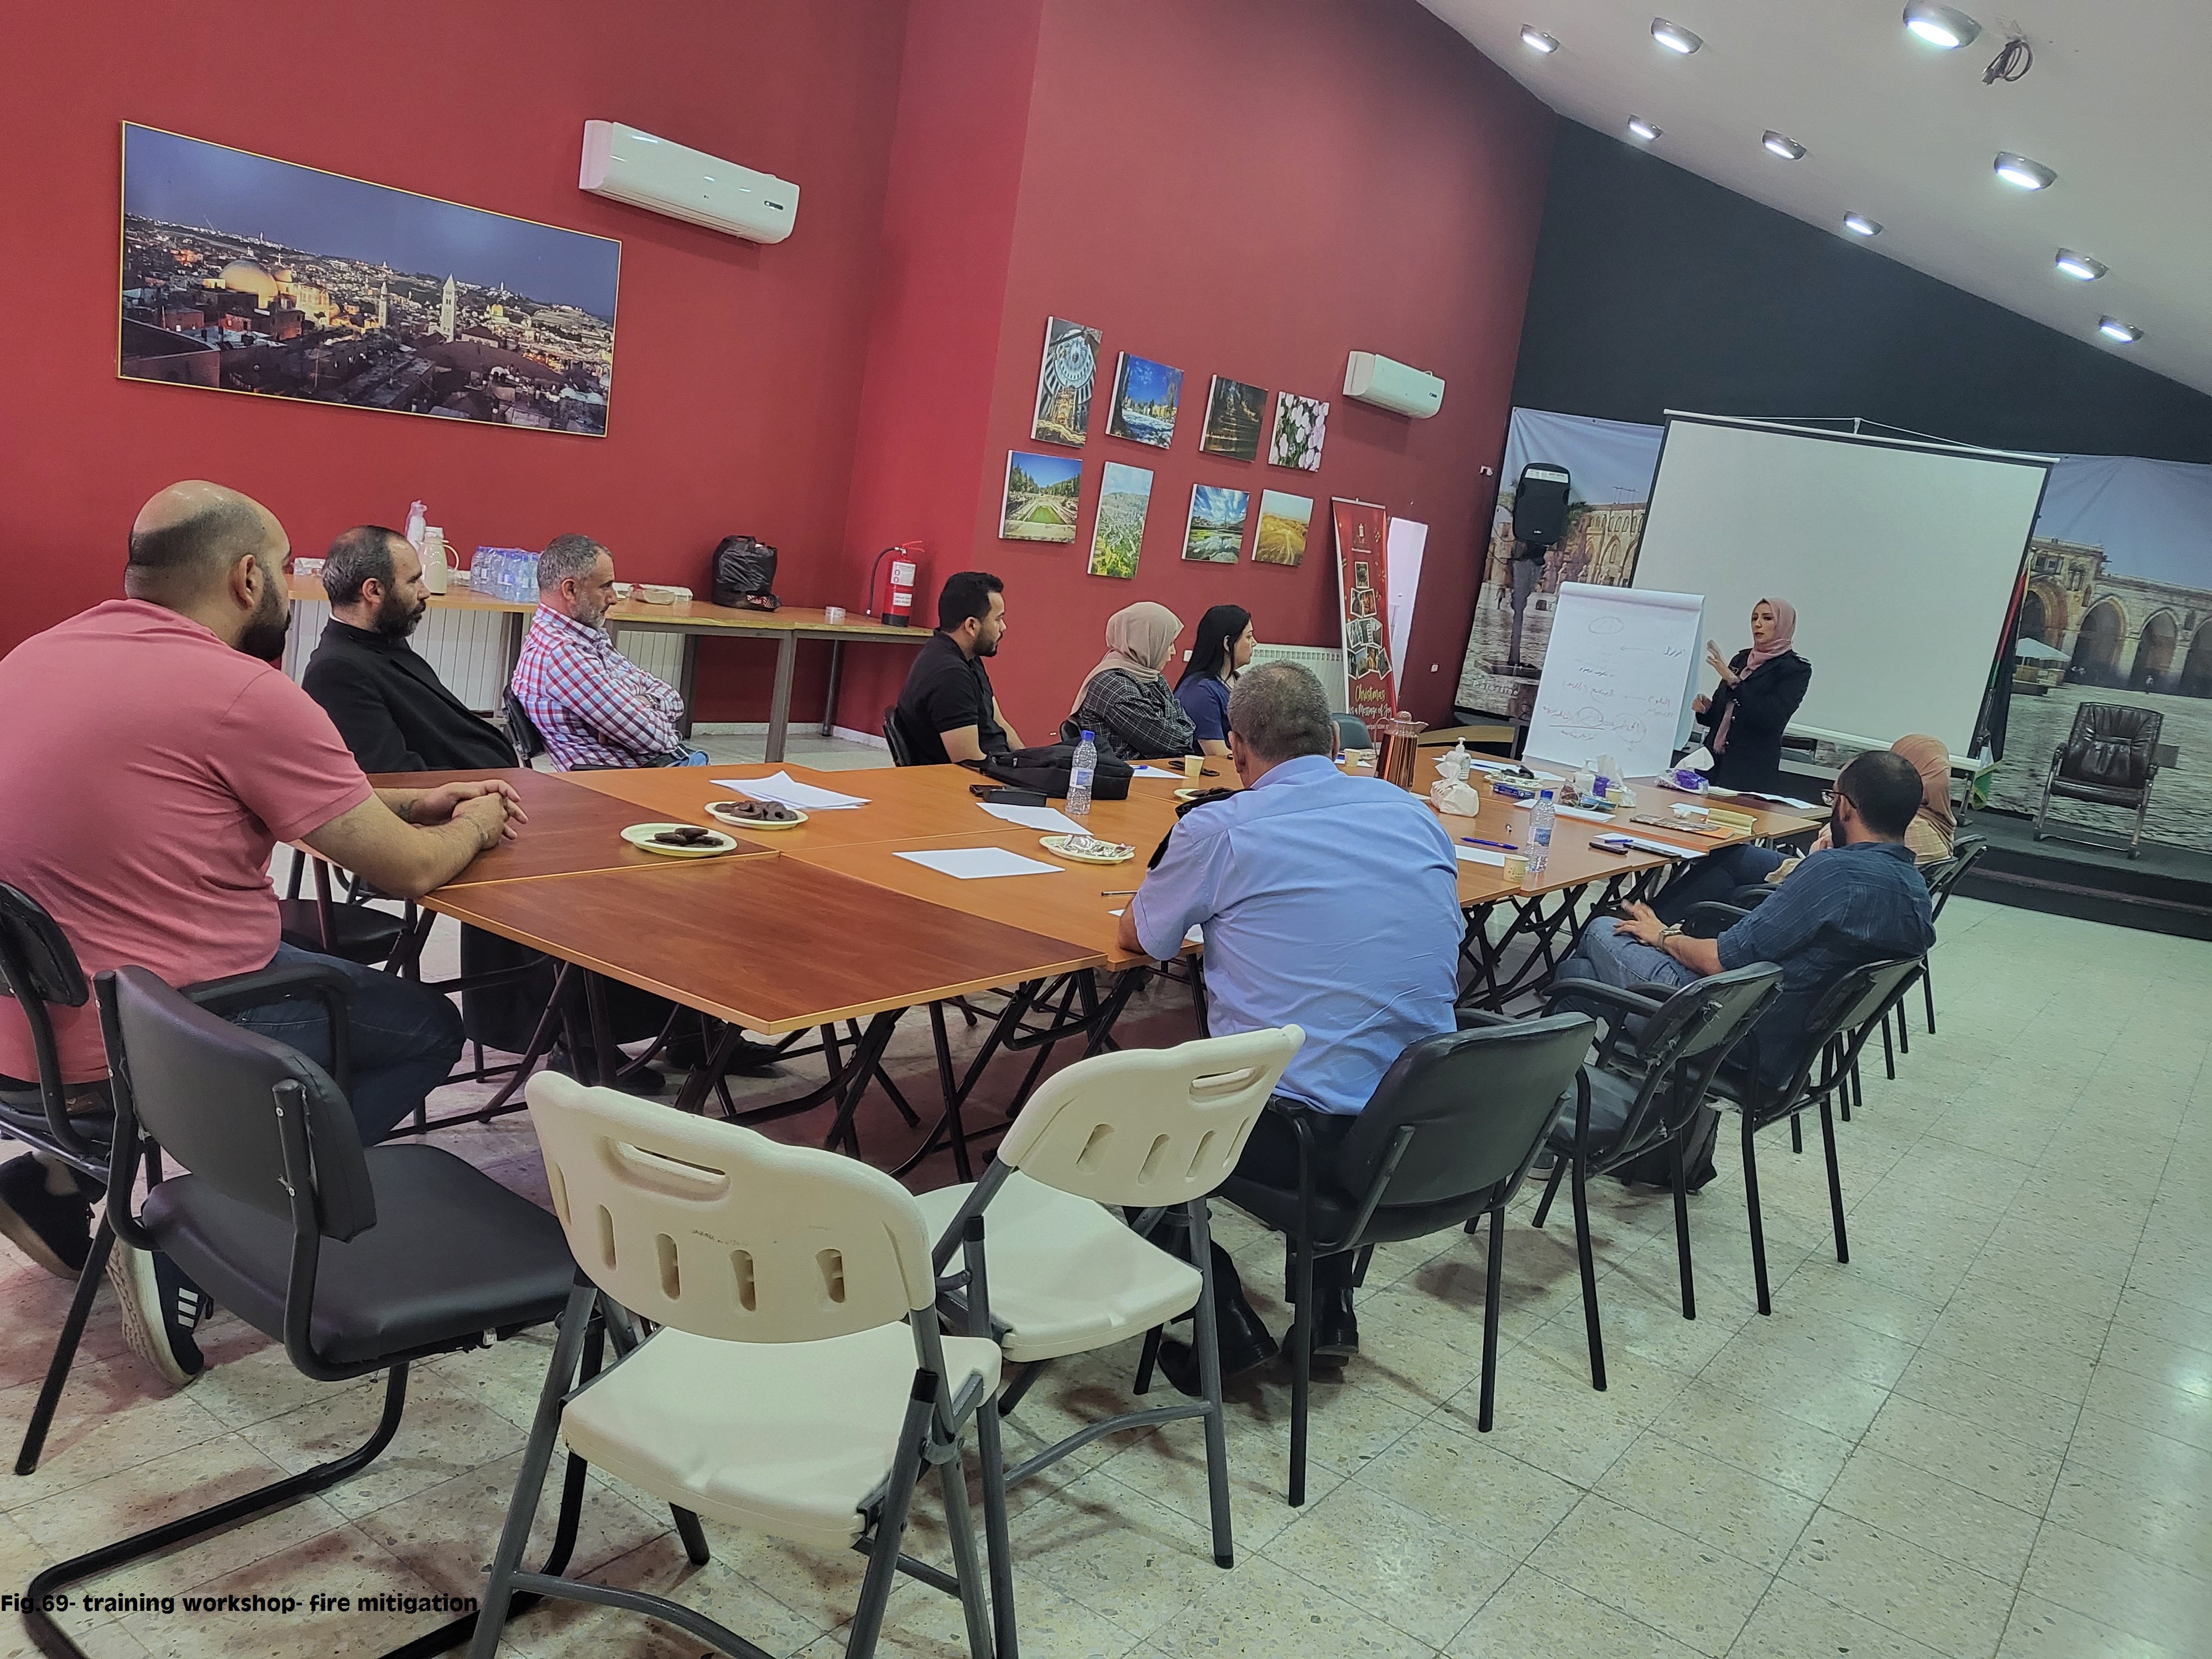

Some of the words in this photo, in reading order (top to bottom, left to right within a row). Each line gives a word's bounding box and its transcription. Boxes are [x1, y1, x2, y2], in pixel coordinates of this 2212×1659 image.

[1355, 683, 1386, 702] Christmas
[1473, 680, 1518, 696] Palestine
[1349, 705, 1354, 715] is
[1358, 703, 1377, 719] Message
[1378, 703, 1384, 717] of
